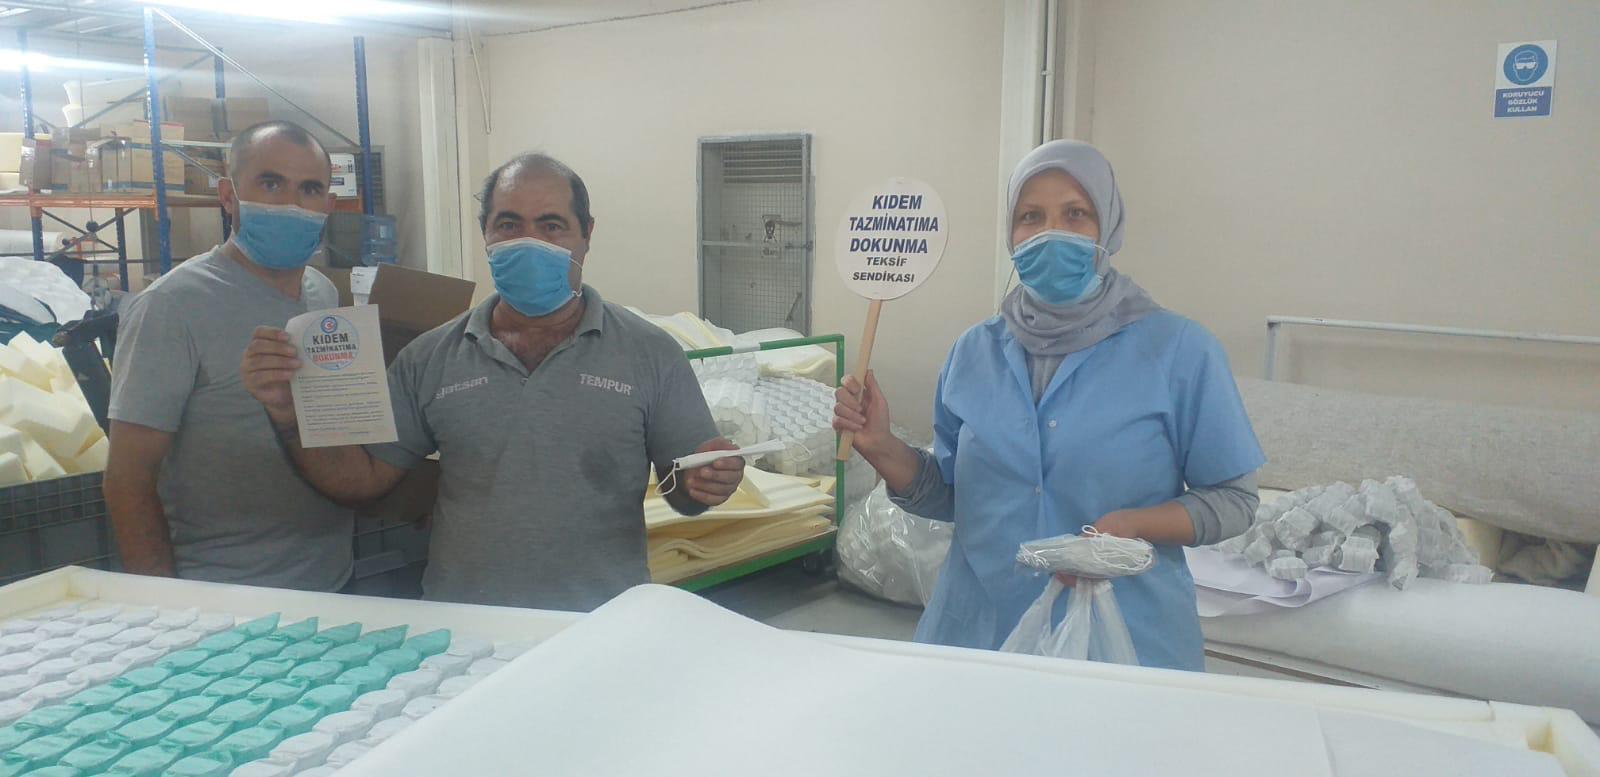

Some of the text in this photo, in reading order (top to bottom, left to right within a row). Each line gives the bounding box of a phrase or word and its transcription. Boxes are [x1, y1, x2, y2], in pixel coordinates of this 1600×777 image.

[872, 194, 923, 210] KIDEM
[849, 212, 939, 232] TAZMİNATIMA
[849, 238, 928, 254] DOKUNMA
[866, 256, 908, 267] TEKSİF
[852, 271, 915, 283] SENDİKASI
[579, 373, 632, 396] TEMPUR
